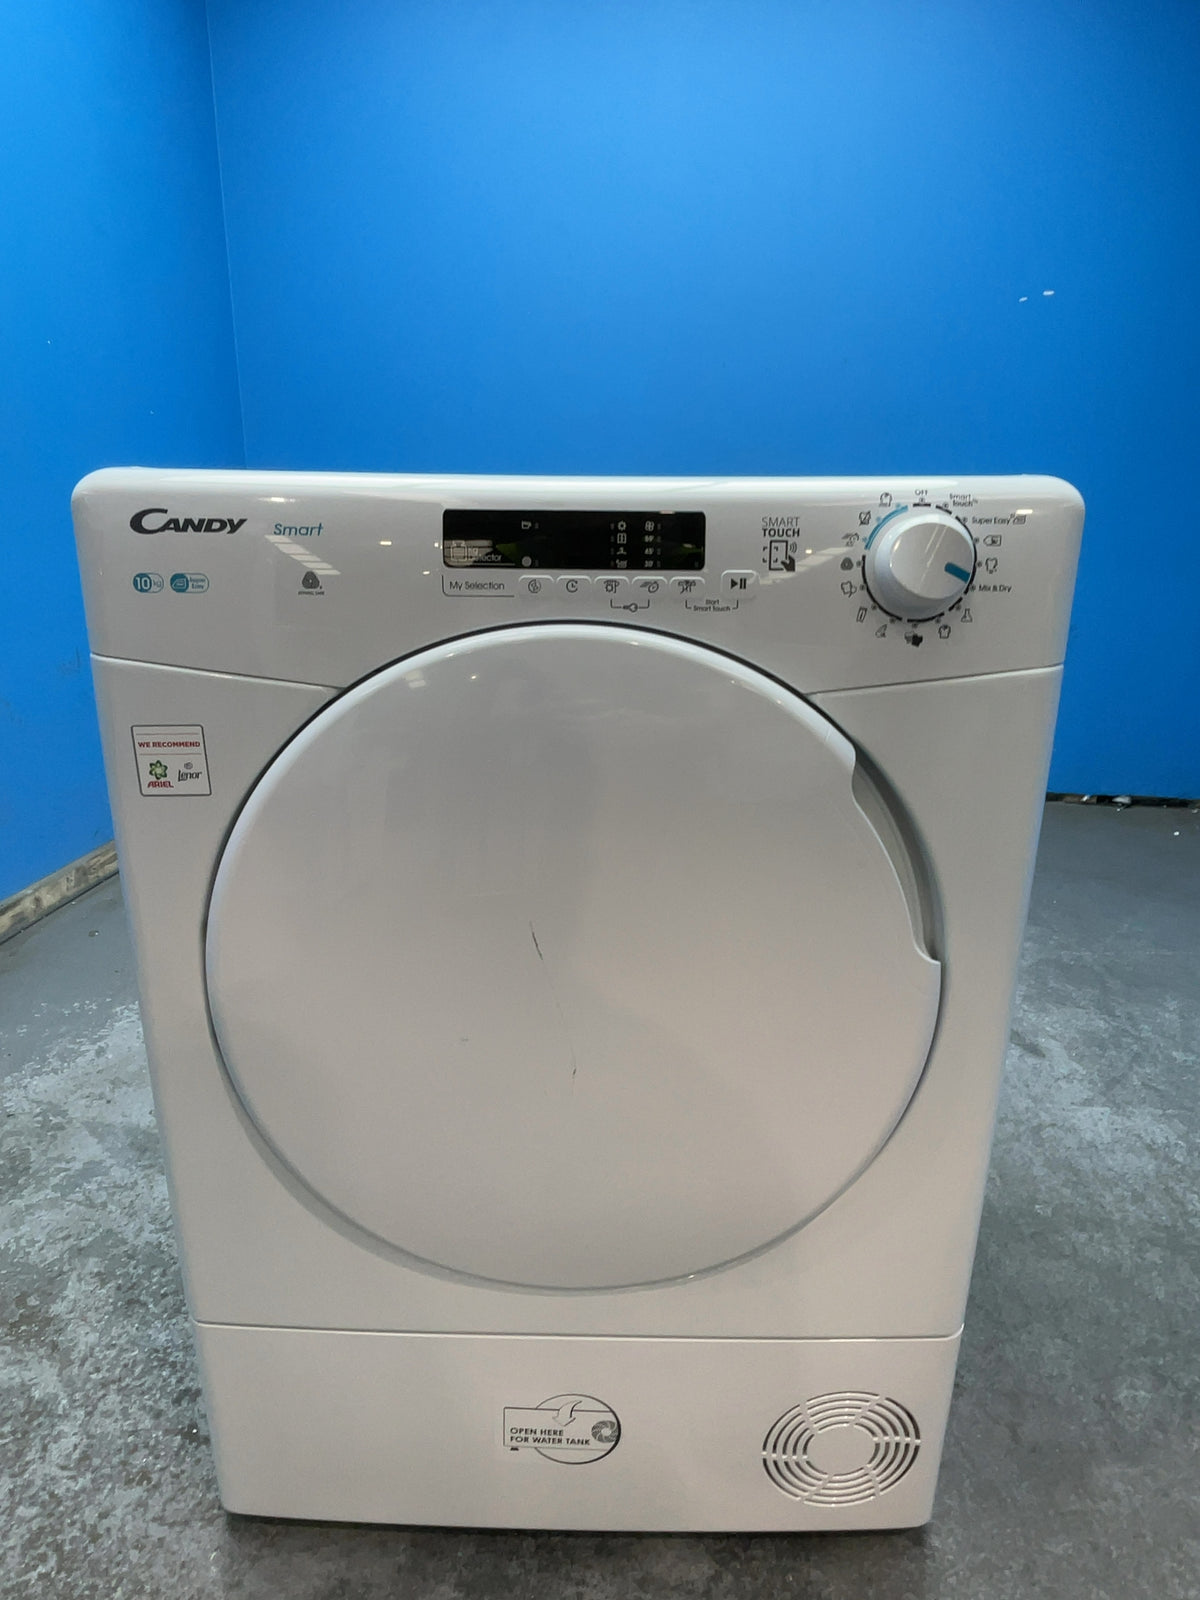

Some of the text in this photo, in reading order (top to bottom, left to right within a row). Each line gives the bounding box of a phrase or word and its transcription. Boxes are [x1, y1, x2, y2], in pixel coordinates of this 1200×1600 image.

[130, 508, 248, 534] CANDY
[761, 516, 799, 527] SMART
[273, 522, 324, 537] Smart
[761, 528, 800, 538] TOUCH
[135, 576, 151, 590] 10
[449, 580, 505, 591] My Selection
[177, 769, 203, 782] Lenor
[510, 1427, 564, 1436] OPEN HERE
[532, 1436, 562, 1445] WATER
